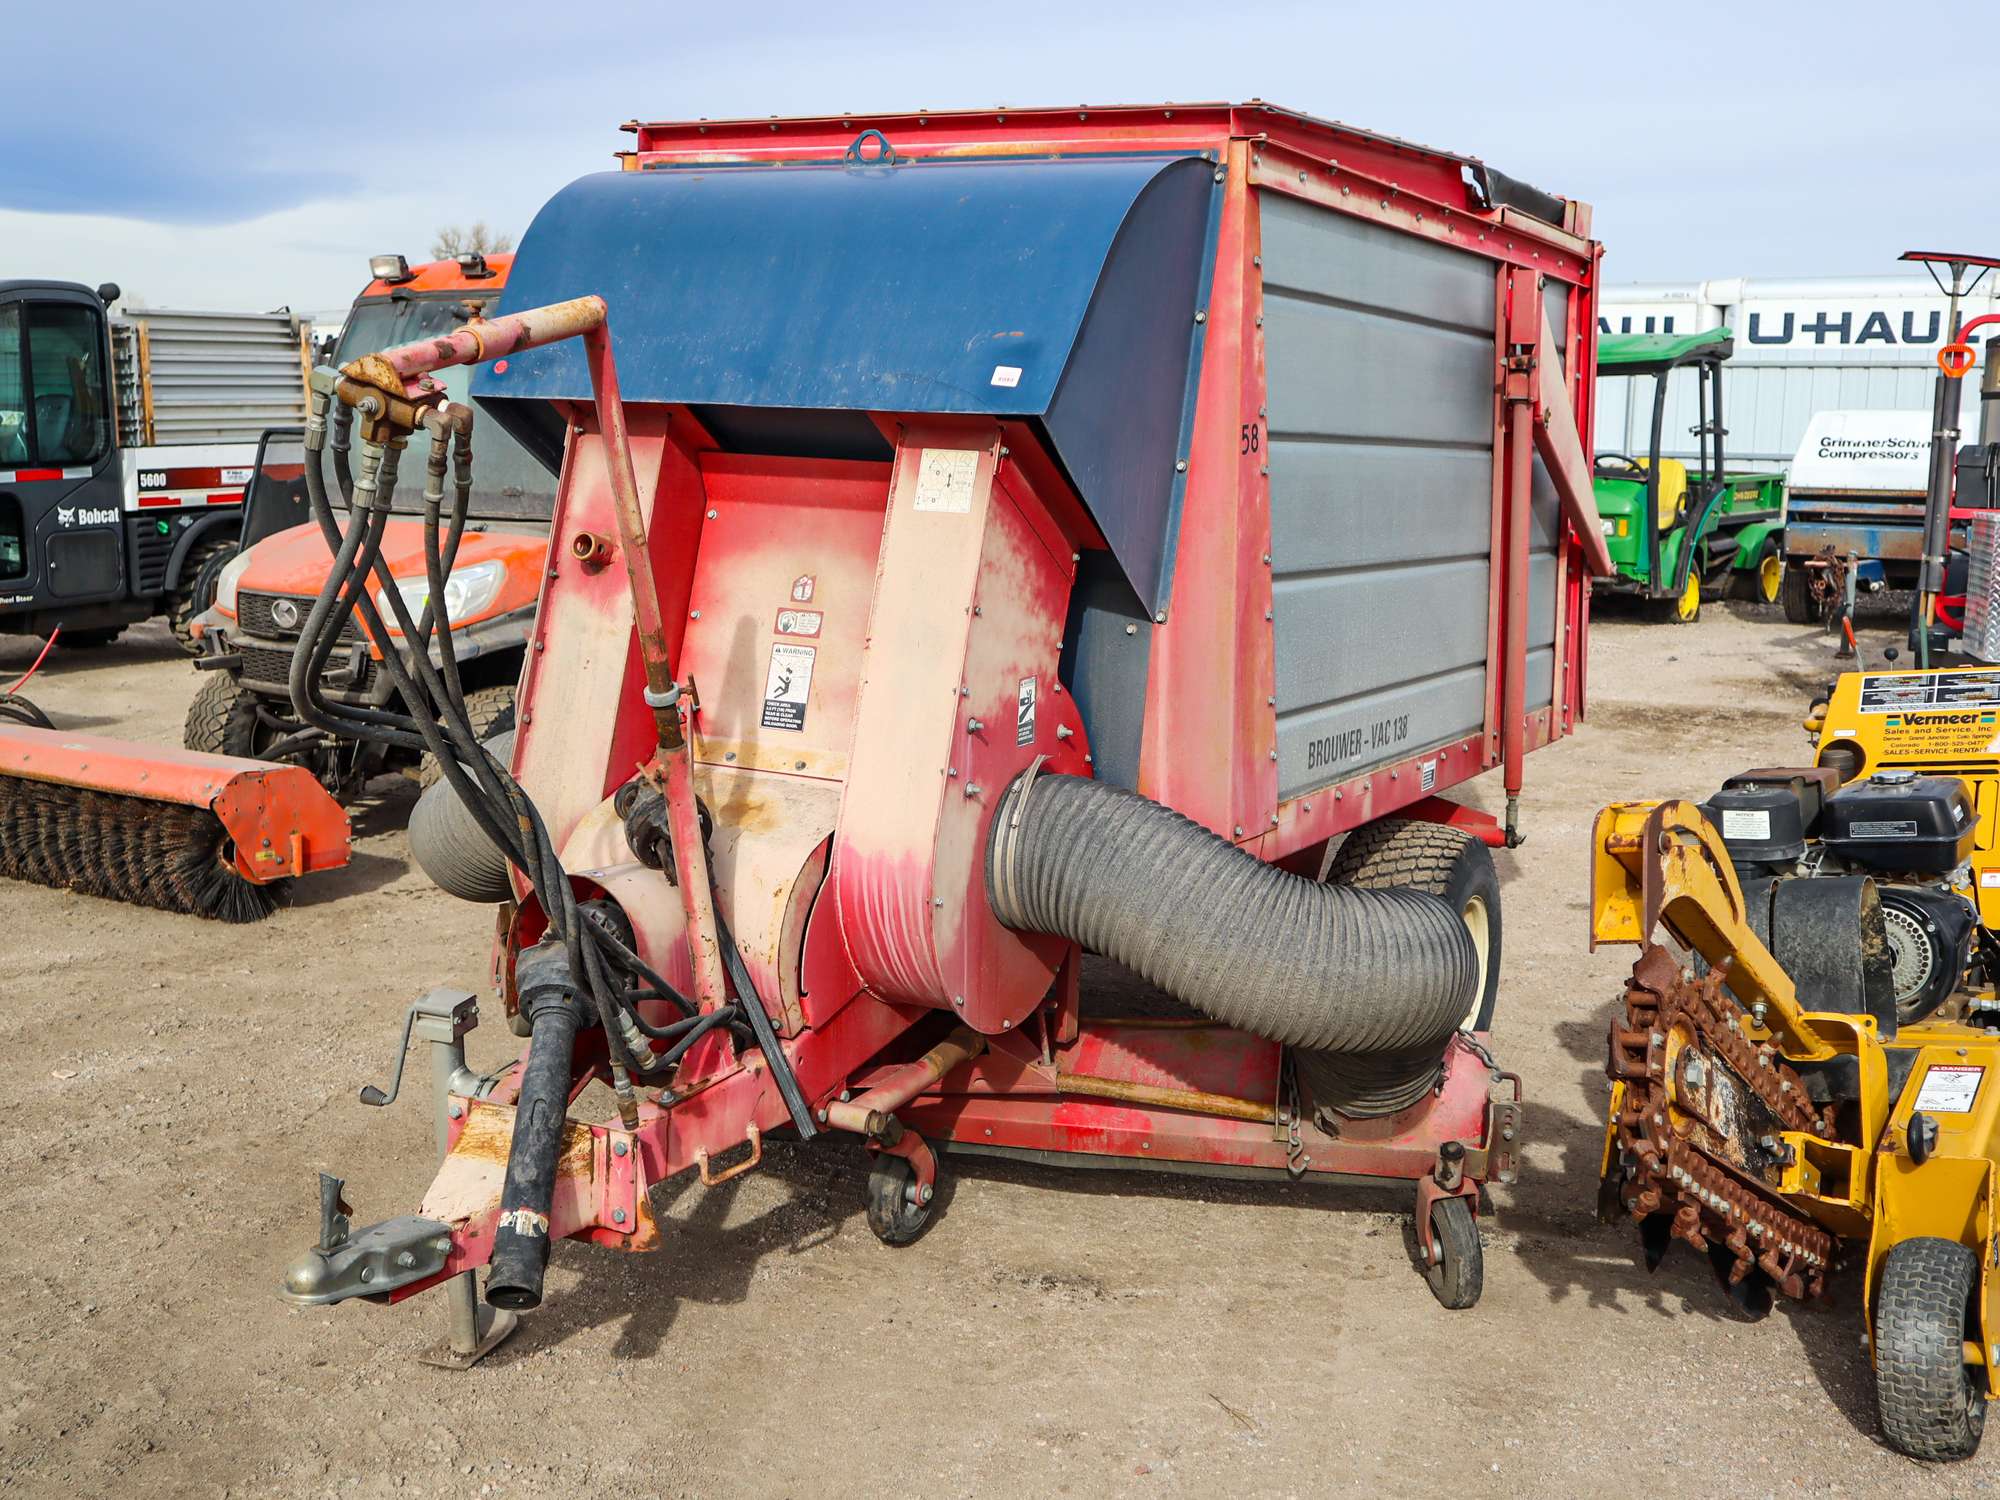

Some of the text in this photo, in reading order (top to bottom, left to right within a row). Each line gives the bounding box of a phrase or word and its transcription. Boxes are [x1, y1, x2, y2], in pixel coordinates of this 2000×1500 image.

[1748, 311, 1980, 345] U-HAUL
[1241, 423, 1259, 455] 58
[1818, 448, 1920, 460] Compressors
[140, 473, 167, 487] 5600
[78, 507, 120, 525] Bobcat
[782, 648, 813, 657] WARNING
[1903, 713, 1979, 726] Vermeer
[1307, 728, 1362, 770] BROUWER
[1371, 719, 1391, 749] VAC
[1393, 714, 1408, 743] 138
